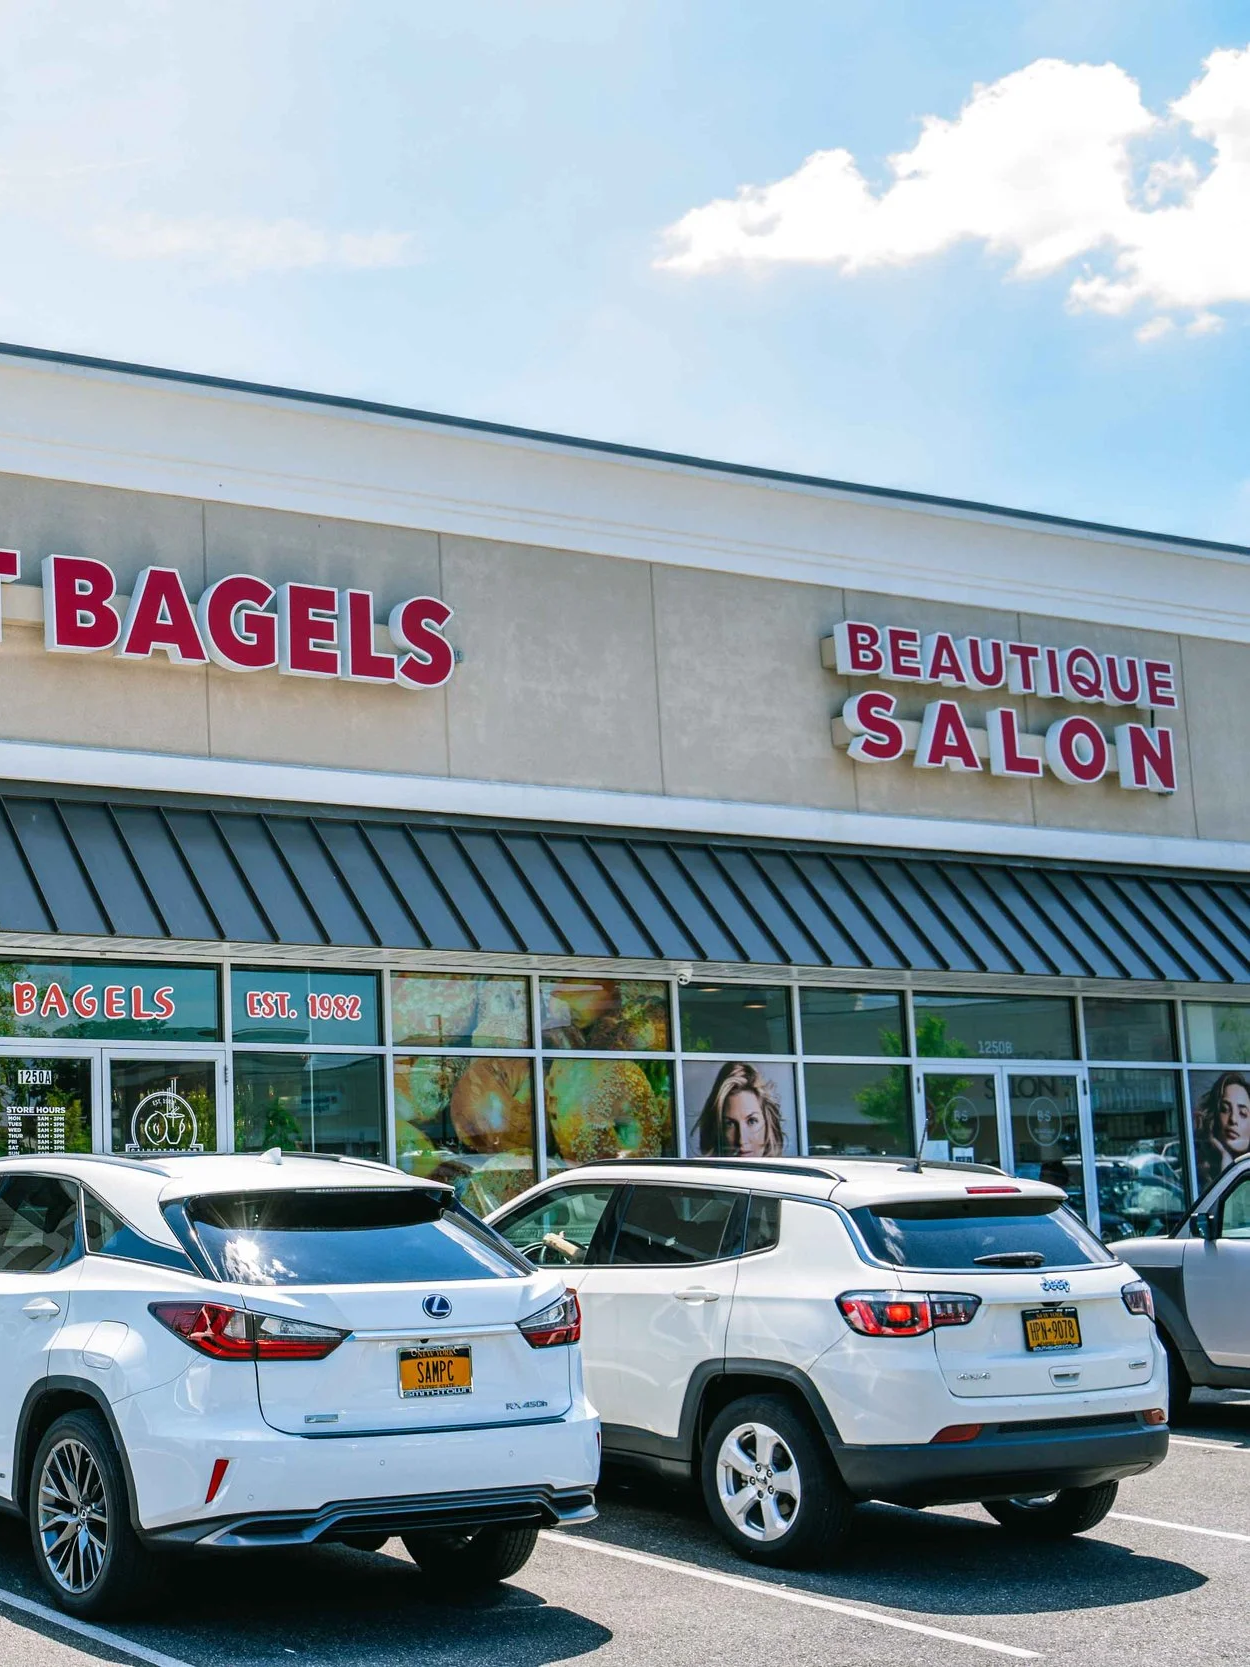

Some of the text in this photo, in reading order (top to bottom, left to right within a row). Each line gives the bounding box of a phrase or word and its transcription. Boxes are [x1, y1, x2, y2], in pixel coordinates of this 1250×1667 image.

[43, 554, 455, 690] BAGELS
[834, 620, 1178, 709] BEAUTIQUE
[843, 690, 1177, 792] SALON
[12, 981, 175, 1021] BAGELS
[246, 991, 363, 1022] EST. 1982
[19, 1070, 51, 1084] 1250A
[6, 1106, 66, 1114] STORE HOURS
[1040, 1277, 1071, 1293] Jeep
[1052, 1319, 1075, 1339] 9078
[436, 1349, 454, 1357] YORK
[416, 1360, 454, 1383] SAMPC
[506, 1402, 522, 1410] RX
